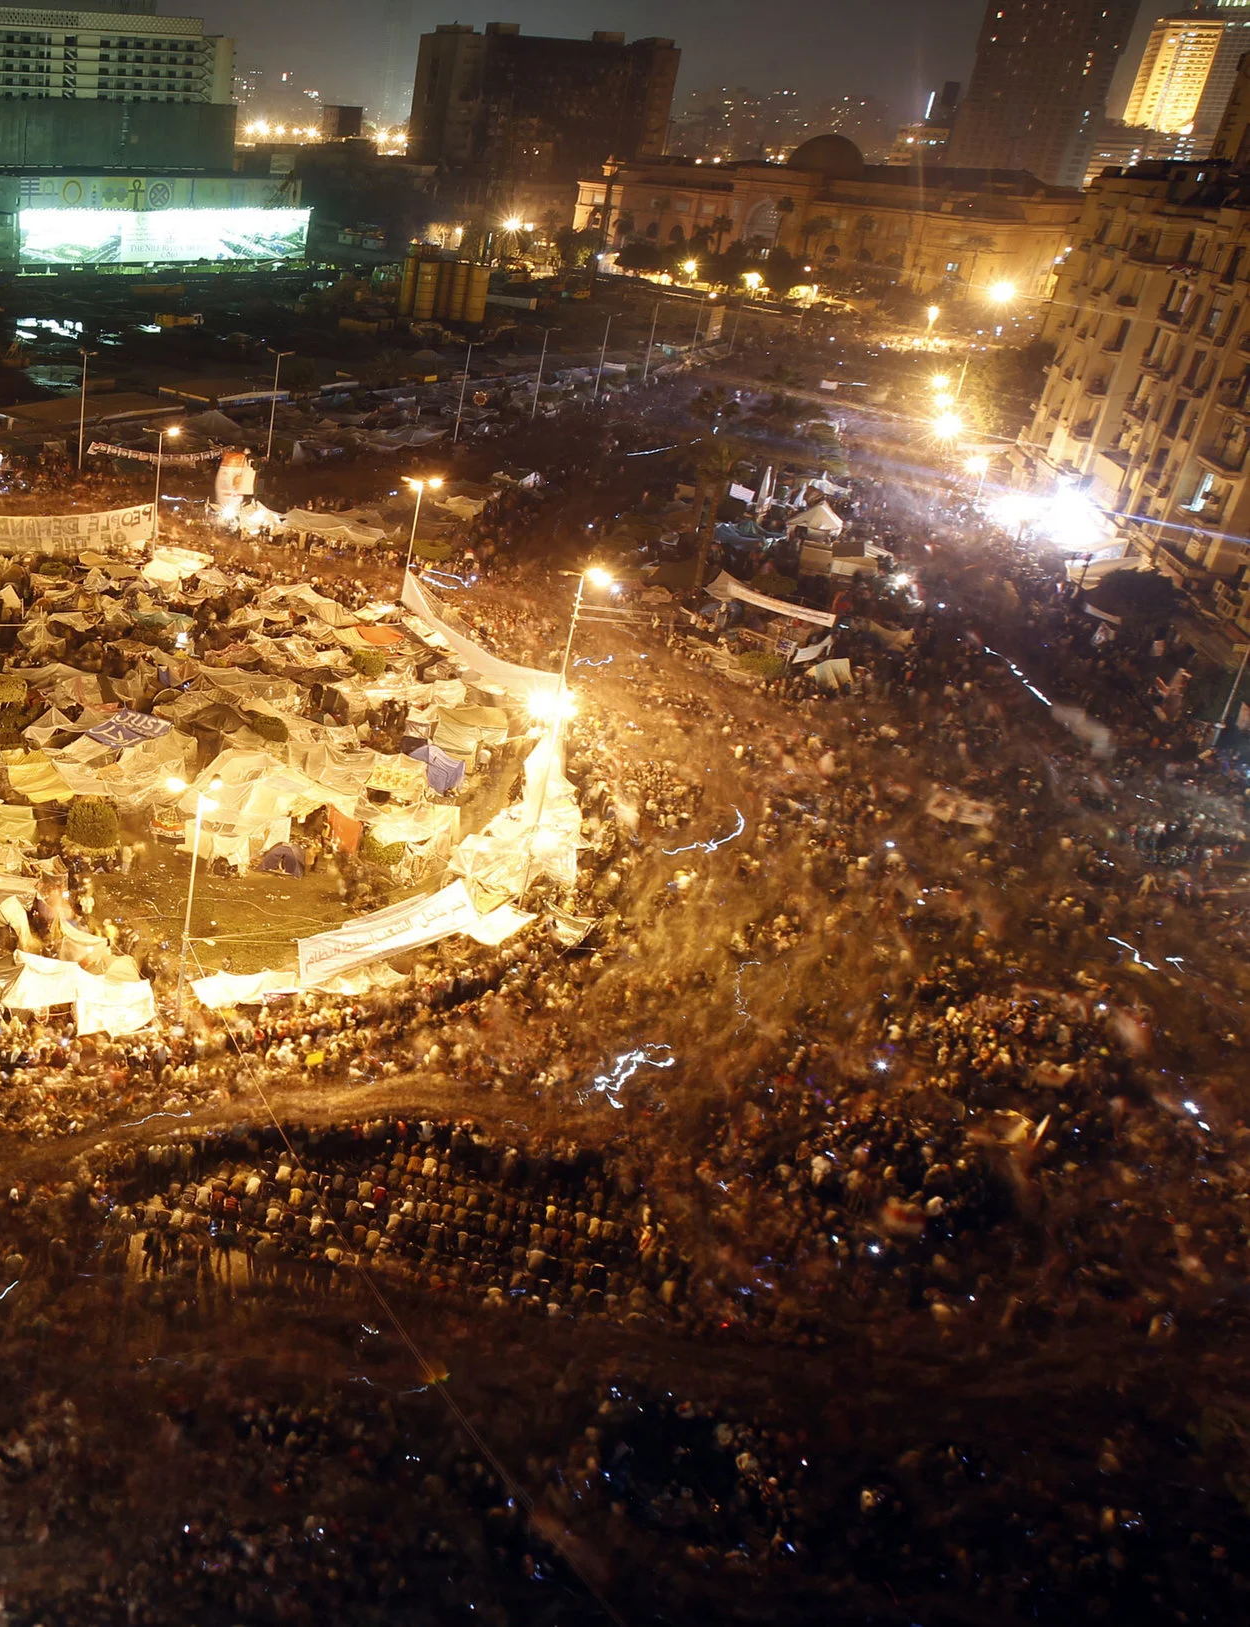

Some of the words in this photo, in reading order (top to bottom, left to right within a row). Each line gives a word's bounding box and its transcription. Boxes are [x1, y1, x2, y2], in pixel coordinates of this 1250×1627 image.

[130, 244, 144, 252] THE
[145, 243, 159, 252] NILE
[115, 711, 172, 734] JUST
